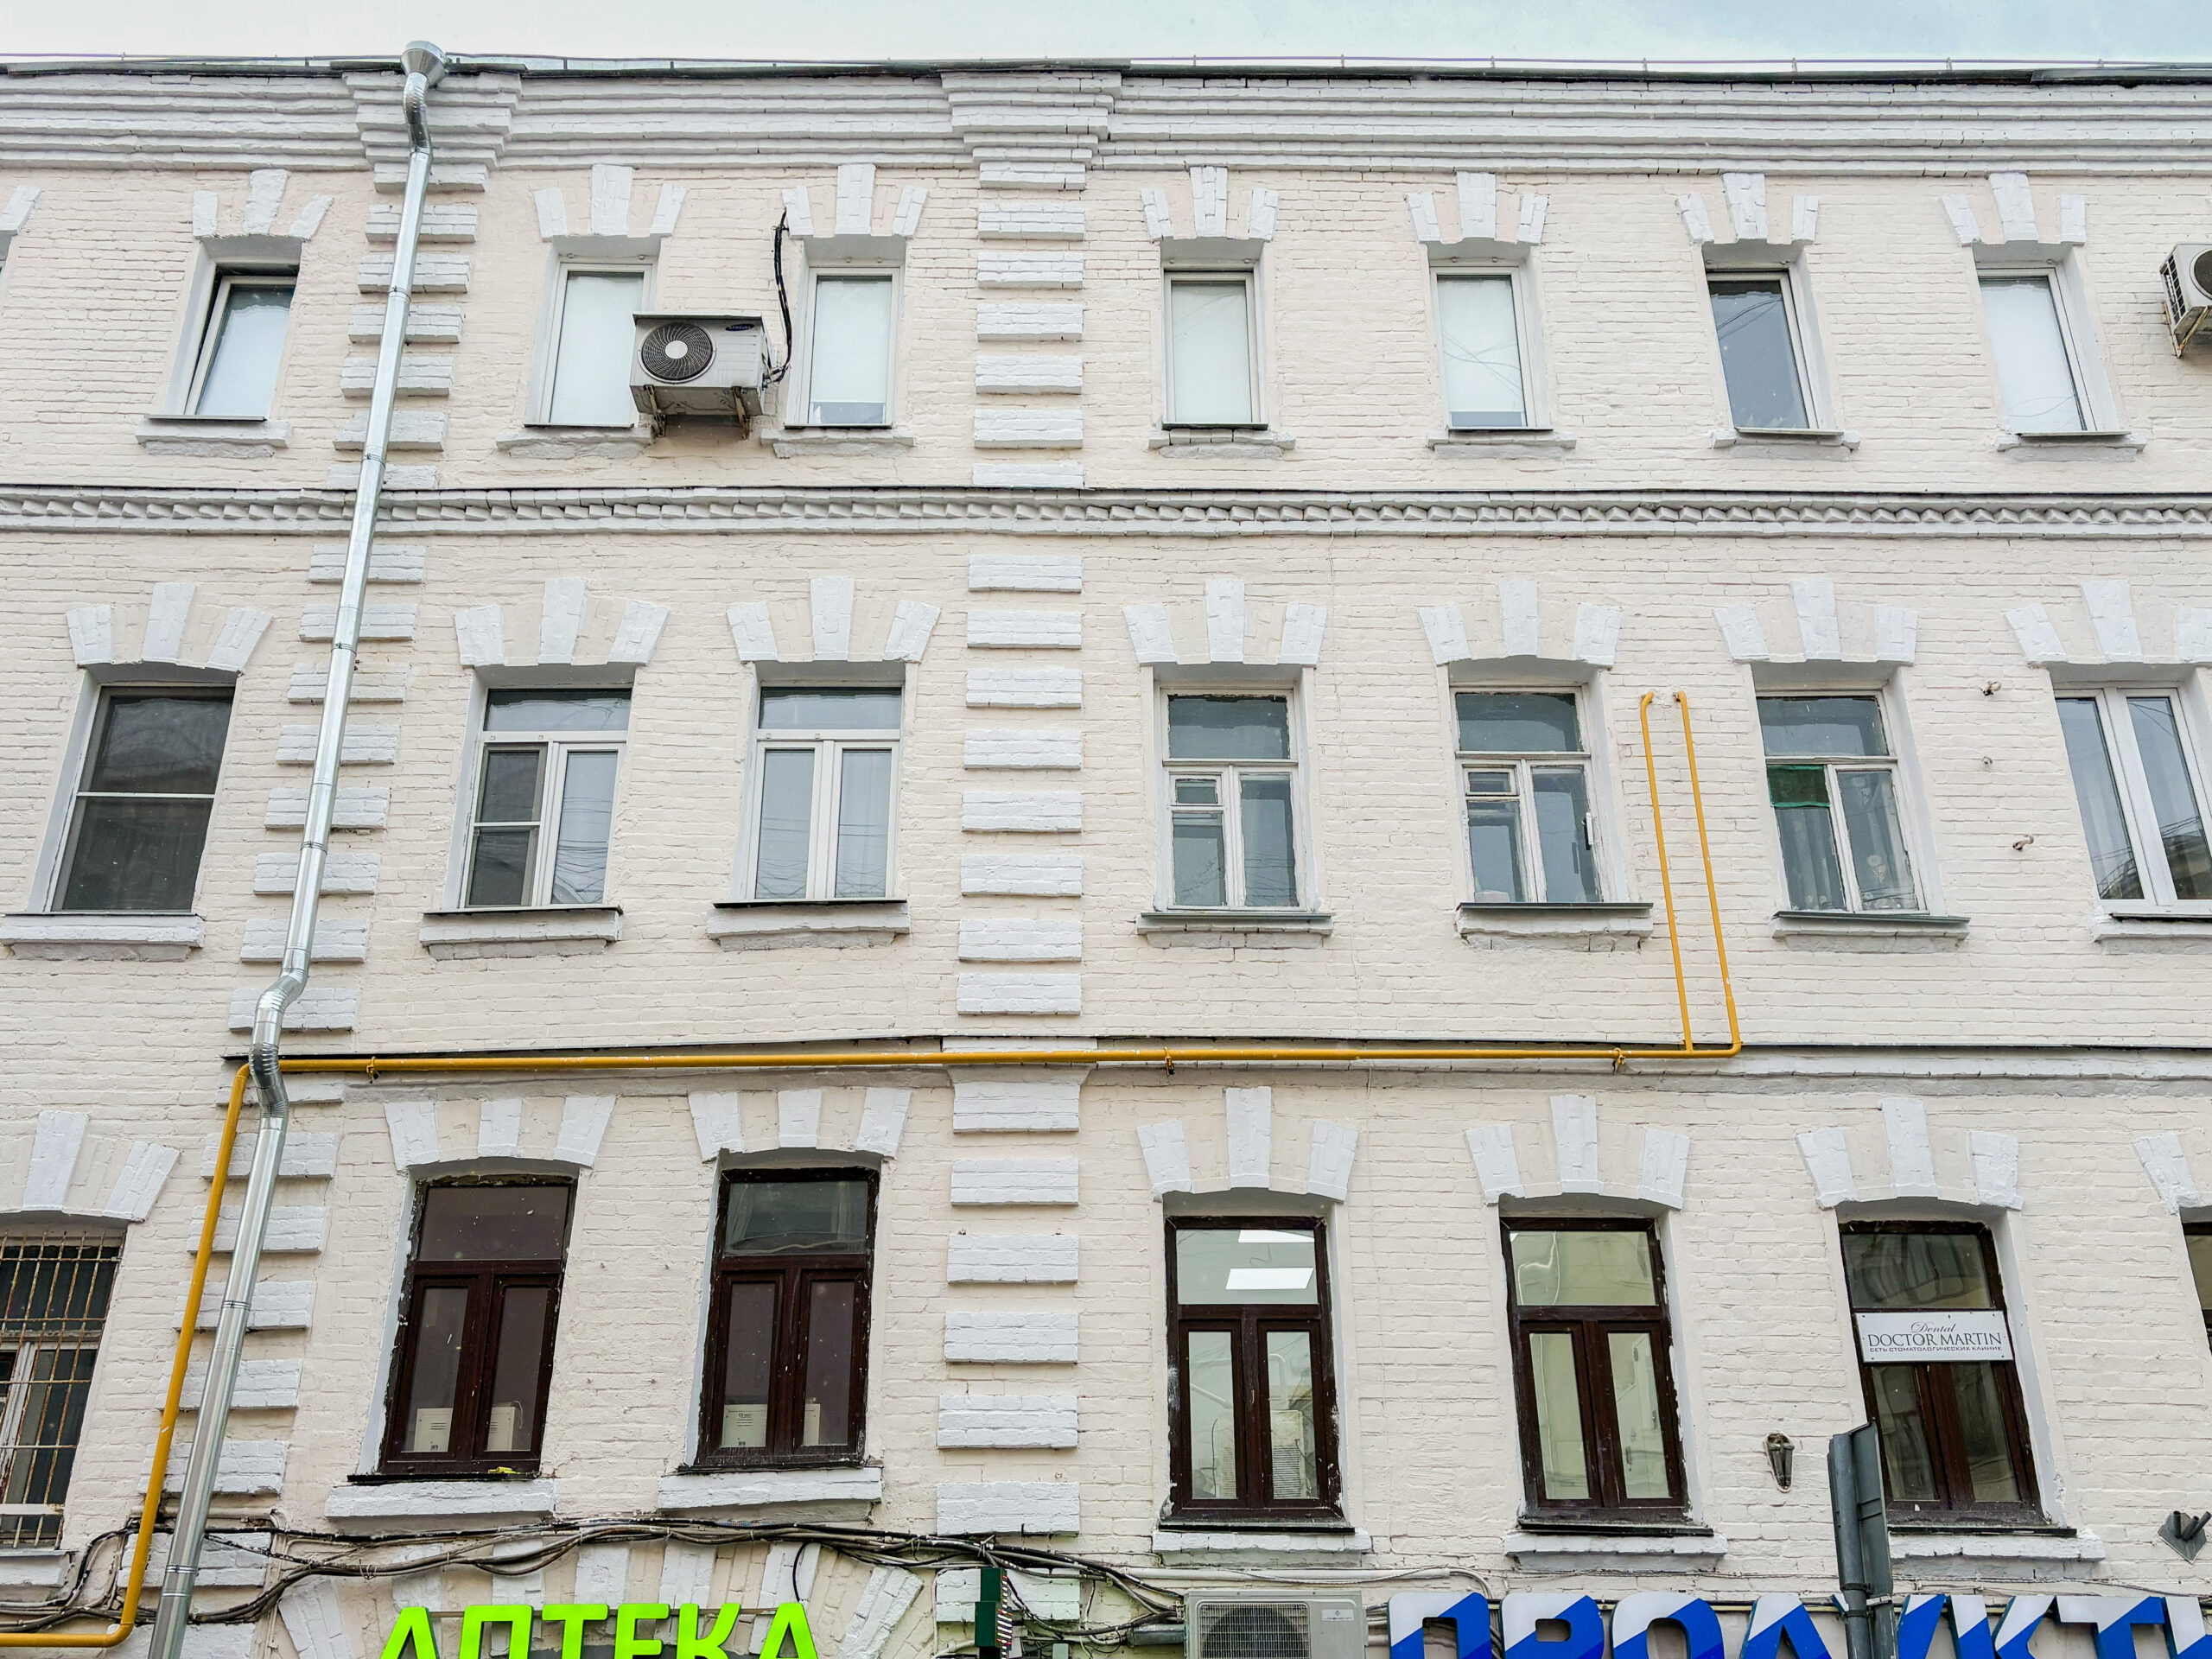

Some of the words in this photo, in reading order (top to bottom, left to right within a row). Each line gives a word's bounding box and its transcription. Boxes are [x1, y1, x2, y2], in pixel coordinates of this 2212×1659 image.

[1910, 1321, 1956, 1333] Dental
[1867, 1333, 1938, 1346] DOCTOR
[1940, 1332, 2002, 1346] MARTIN
[379, 1603, 820, 1659] АПТЕКА
